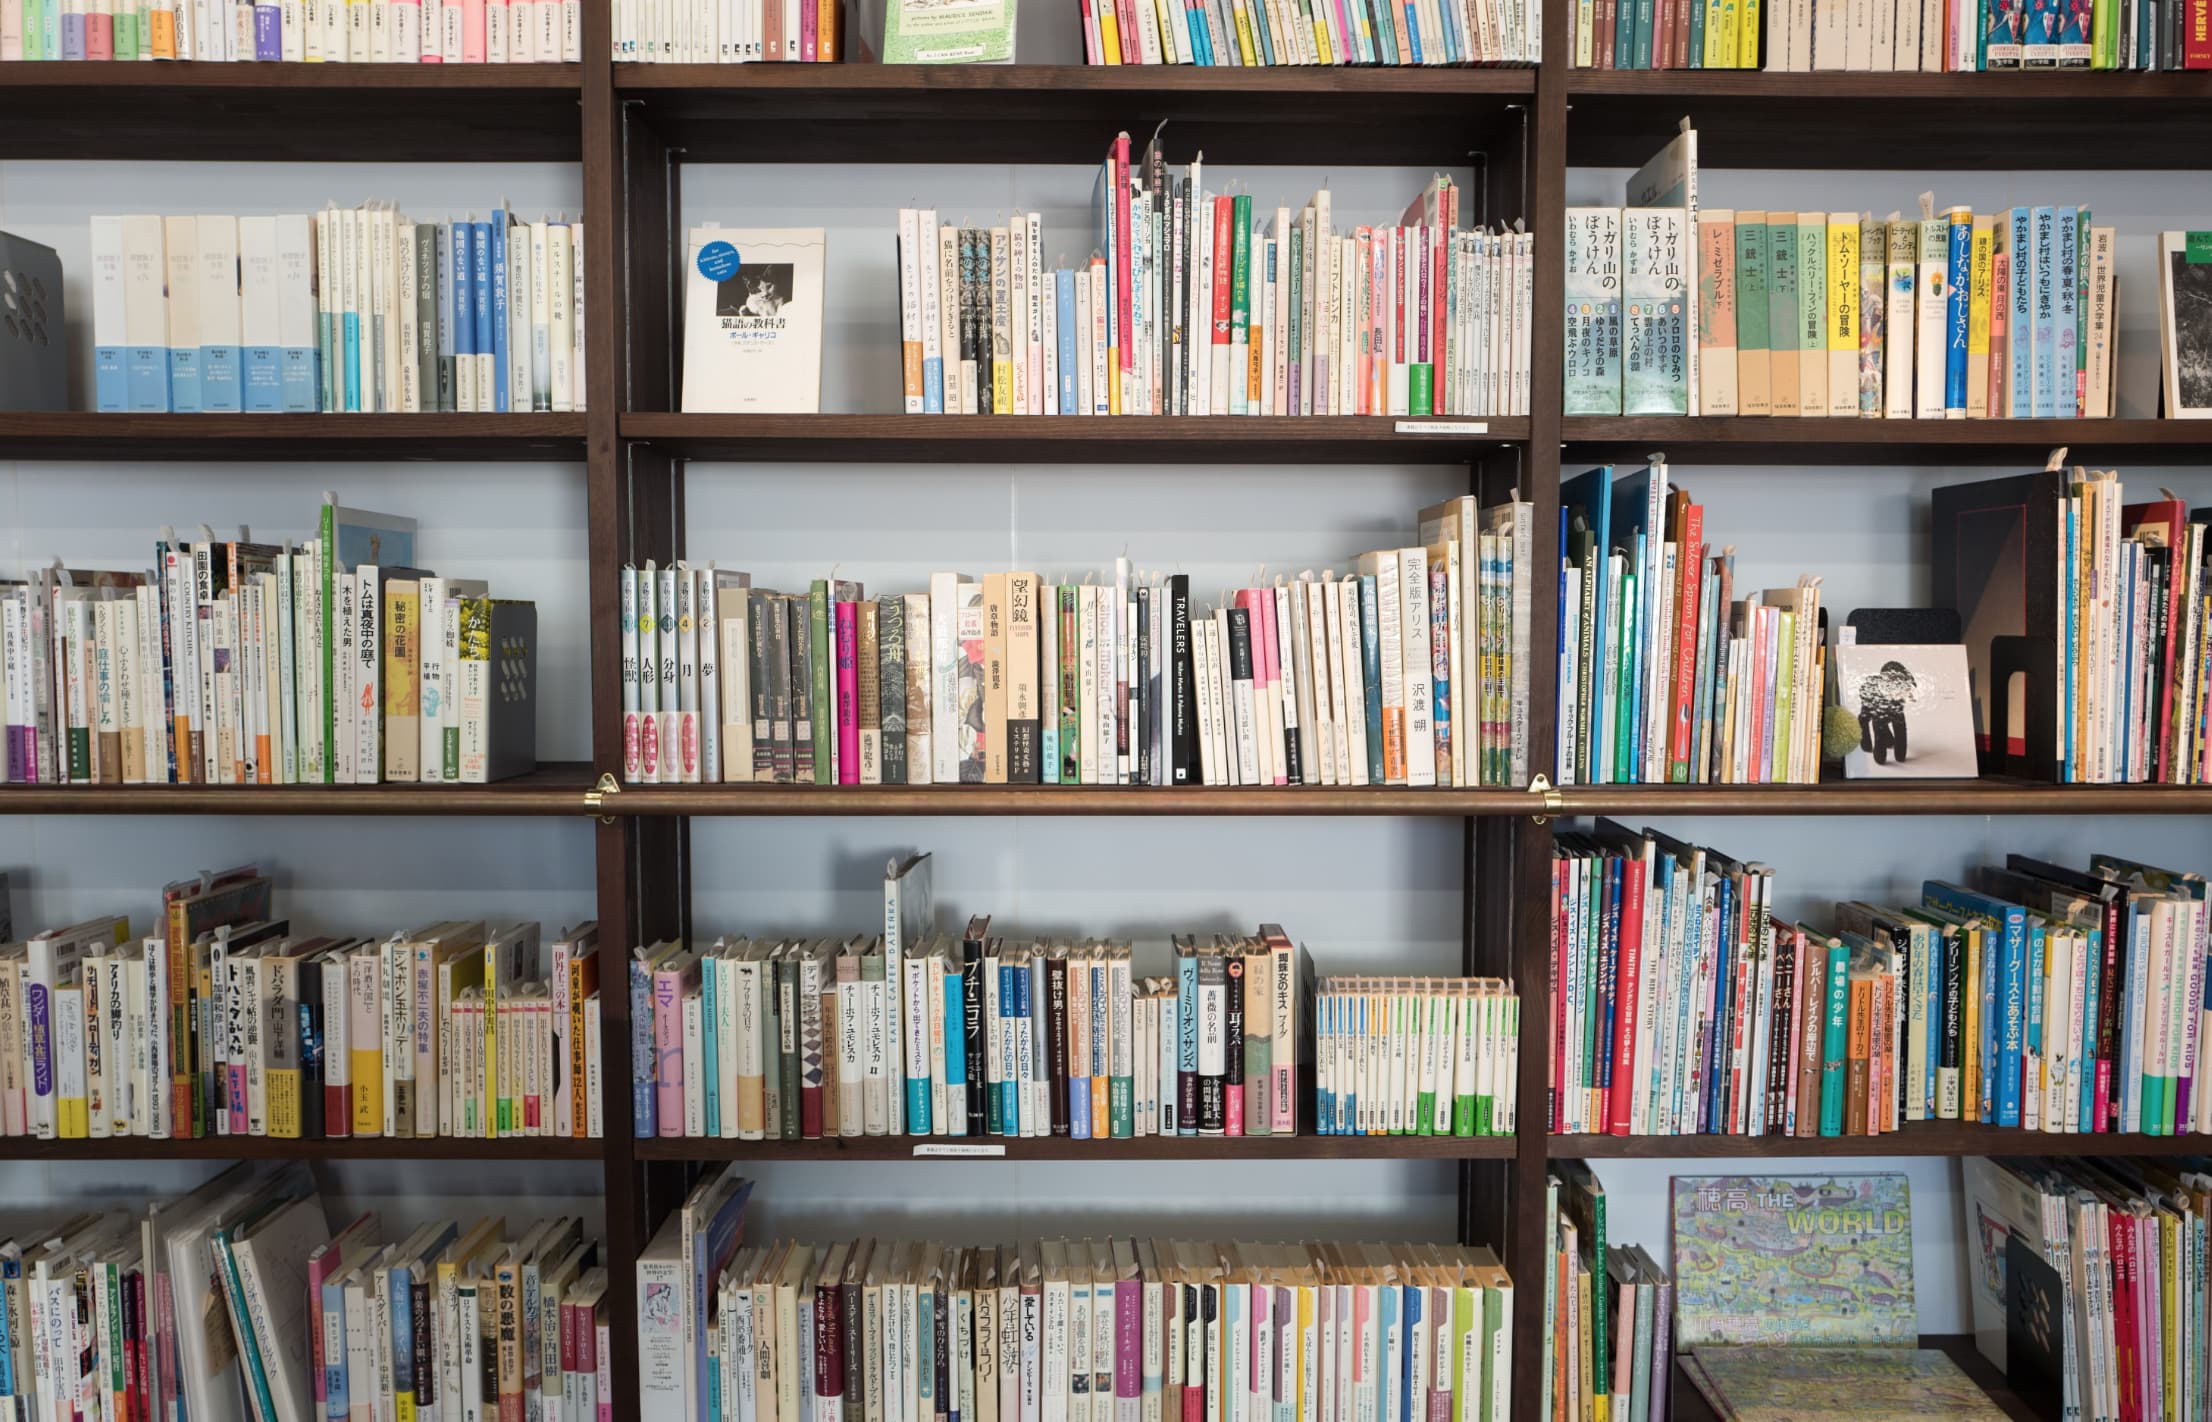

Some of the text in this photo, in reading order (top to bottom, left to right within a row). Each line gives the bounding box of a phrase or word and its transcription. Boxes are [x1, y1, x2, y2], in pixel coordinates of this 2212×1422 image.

[456, 230, 466, 318] 地図のない道 須賀敦子
[476, 230, 487, 318] 地図のない道 須賀敦子
[1569, 216, 1577, 273] いわむら かずお
[1585, 216, 1617, 290] トガリ山の ぼうけん
[1629, 217, 1637, 274] いわむら かずお
[1647, 217, 1679, 291] トガリ山の ぼうけん
[1712, 229, 1724, 310] レ・ミゼラブル 下
[1745, 230, 1757, 278] 三銃士
[1775, 232, 1788, 279] 三銃士
[1978, 237, 1988, 297] 鏡の国のアリス
[2015, 216, 2027, 314] やかまし村の子どもたち
[2039, 215, 2051, 319] やかまし村はいつもにぎやか
[2061, 216, 2073, 314] やかまし村の春・夏・秋・冬
[420, 240, 431, 354] ヴェネツィアの宿 須賀敦子
[495, 263, 505, 311] 須賀敦子
[552, 241, 562, 321] ユルスナールの靴
[995, 234, 1008, 327] アブサンの置土産
[1806, 233, 1817, 338] ハックルベリー・フィンの冒険
[1839, 232, 1850, 338] トム・ソーヤーの冒険
[1954, 225, 1970, 349] あしながおじさん
[1995, 260, 2006, 320] 太陽の東 月の西
[2095, 266, 2106, 331] 世界児童文学集
[721, 317, 787, 329] 猫語の教科書
[729, 331, 777, 339] ポール・ギャリコ
[1567, 317, 1577, 377] 空飛ぶウロロ
[1581, 317, 1591, 377] 月夜のキノコ
[1595, 317, 1605, 376] ゆうだちの森
[1608, 317, 1618, 358] 風の草原
[1630, 318, 1640, 372] てっぺんの湖
[1658, 318, 1667, 373] あいつのすず
[1671, 318, 1680, 382] ウロロのひみつ
[184, 581, 192, 624] COUNTRY
[197, 550, 210, 601] 田園の食卓
[1013, 578, 1029, 623] 望幻鏡
[1407, 558, 1423, 639] 完全版アリス
[342, 586, 353, 647] 木を植えた男
[360, 579, 376, 669] トムは真夜中の庭で
[394, 601, 407, 658] 秘密の花園
[1175, 596, 1185, 654] TRAVELERS
[1582, 555, 1591, 657] AN ALPHABET of ANIMALS
[1680, 517, 1701, 698] The Silver Spoon for Children
[467, 616, 481, 659] かたち
[99, 648, 112, 725] 庭仕事の愉しみ
[624, 657, 637, 683] 怪獣
[642, 657, 654, 684] 人形
[663, 657, 675, 684] 分身
[682, 663, 692, 677] 月
[702, 662, 714, 677] 夢
[1412, 684, 1427, 732] 沢渡朔
[110, 964, 122, 1041] アメリカの鱒釣り
[213, 984, 224, 1022] 加藤和彦
[271, 965, 285, 1019] ドバラダ門
[364, 960, 374, 1013] 「洋酒天国」と
[658, 979, 674, 1008] エマ
[742, 979, 753, 1033] アフリカの日々
[964, 960, 981, 1040] プチ・ニコラ
[1052, 970, 1063, 1010] 壁抜け男
[1278, 952, 1288, 1010] 蜘蛛女のキス
[1645, 959, 1656, 1031] THE BIBLE STORY
[1736, 976, 1746, 1036] オリビア
[1831, 960, 1846, 1028] 農場の少年
[1911, 935, 1924, 1021] あの年の春は早くきた
[2006, 925, 2022, 1051] マザーグースとあそぶ本
[417, 969, 429, 1054] 赤塚不二夫の特集
[663, 1014, 673, 1047] オースティン
[845, 984, 855, 1063] チェーホフ・ユモレスカ
[871, 984, 881, 1063] チェーホフ・ユモレスカ
[888, 1019, 897, 1044] KAREL
[911, 972, 922, 1074] ポケットから出てきたミステリー
[1183, 968, 1193, 1068] ヴァーミリオン・サンズ
[1207, 990, 1217, 1044] 薔薇の名前
[1229, 1011, 1241, 1046] 耳ラッパ
[1805, 957, 1822, 1062] シルバー・レイクの岸辺で
[1855, 986, 1866, 1057] ドリトル先生のサーカス
[2184, 973, 2199, 1069] GOODS FOR KIDS
[272, 1022, 285, 1059] 山下洋輔
[1004, 1020, 1013, 1077] うたかたの日々
[1020, 1020, 1029, 1078] うたかたの日々
[359, 1084, 369, 1115] 小玉武
[1696, 1186, 1749, 1212] 穂高
[1757, 1193, 1795, 1208] THE
[1785, 1209, 1905, 1235] WORLD
[7, 1284, 20, 1349] 森と氷河と鯨
[49, 1287, 62, 1348] バスにのって
[375, 1275, 388, 1336] アースダイバー
[499, 1284, 515, 1342] 数の悪魔
[1023, 1296, 1036, 1342] 愛している
[543, 1296, 557, 1377] 橋本治と内田樹
[960, 1313, 969, 1360] くちづけ
[978, 1293, 992, 1383] バタフライはフリー
